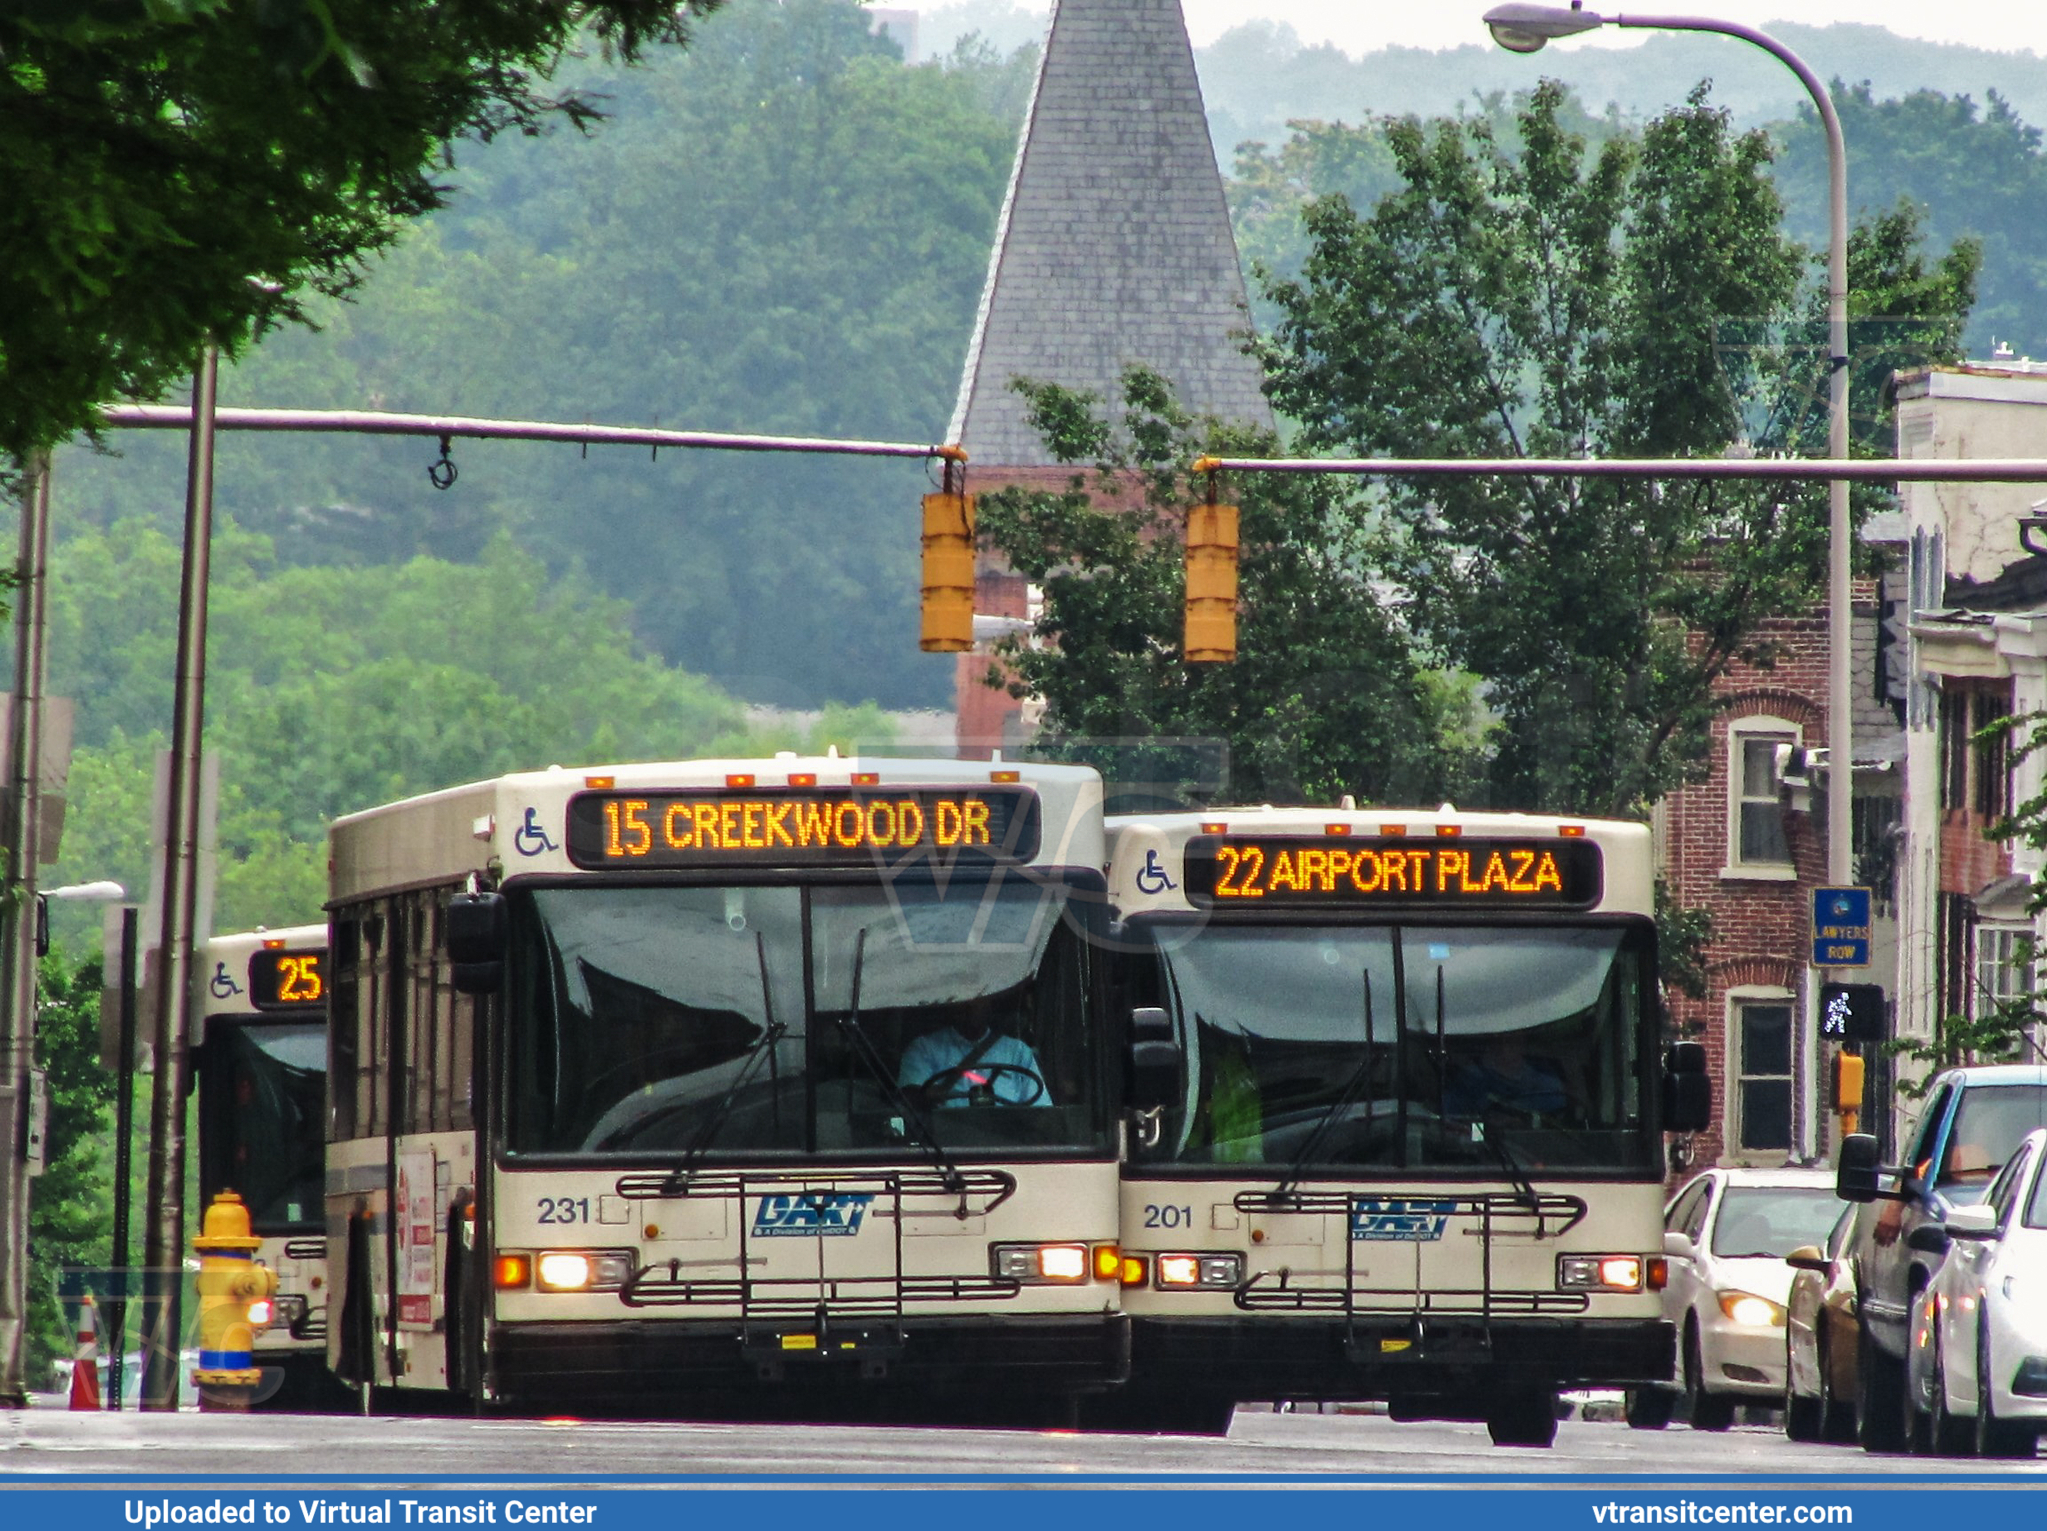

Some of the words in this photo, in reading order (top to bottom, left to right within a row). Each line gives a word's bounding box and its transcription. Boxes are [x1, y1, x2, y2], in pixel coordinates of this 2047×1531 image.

[605, 801, 652, 856] 15
[665, 801, 923, 848] CREEKWOOD
[936, 801, 991, 846] DR
[1216, 847, 1265, 896] 22
[1269, 851, 1431, 892] AIRPORT
[1438, 851, 1563, 892] PLAZA
[1815, 925, 1868, 940] LAWYERS
[1828, 945, 1856, 959] ROW
[277, 956, 322, 1000] 25
[538, 1198, 588, 1223] 231
[1144, 1205, 1191, 1228] 201
